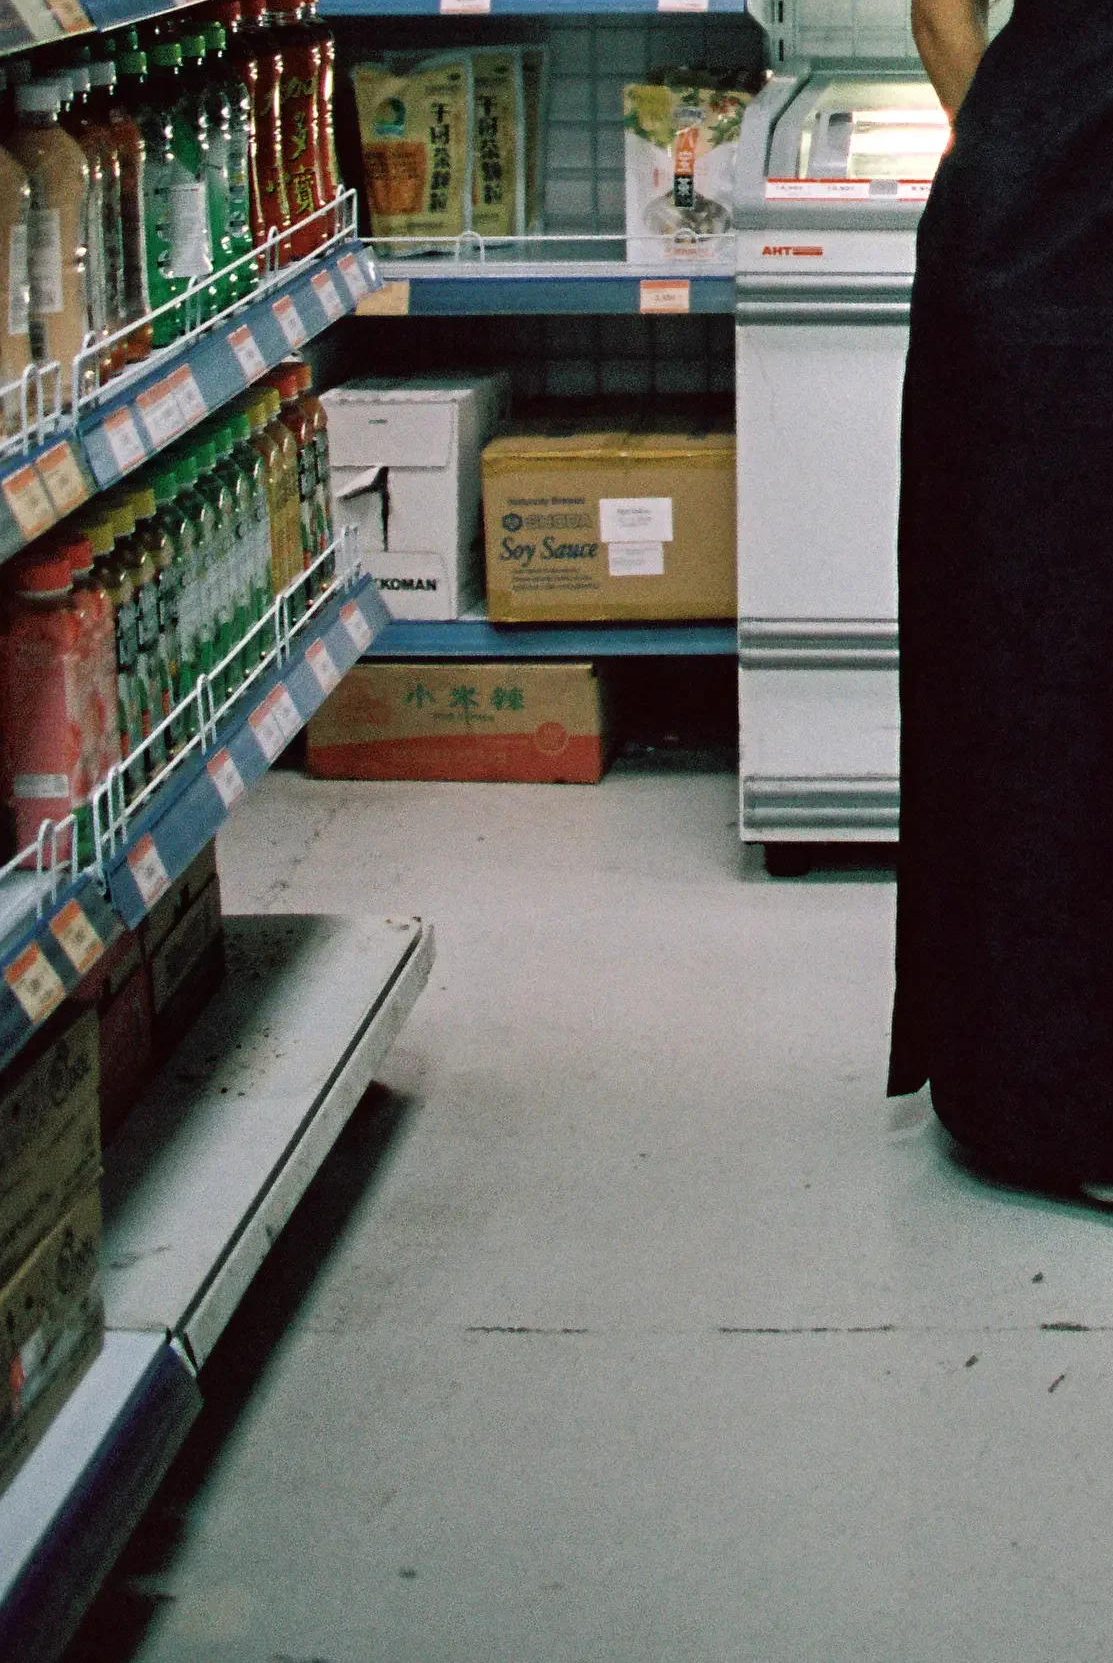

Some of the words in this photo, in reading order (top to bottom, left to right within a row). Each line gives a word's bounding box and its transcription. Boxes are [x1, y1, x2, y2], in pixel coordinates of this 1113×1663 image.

[762, 246, 792, 256] AHT
[499, 535, 537, 568] Soy
[541, 535, 600, 560] Sauce
[402, 683, 526, 712] 小米辣
